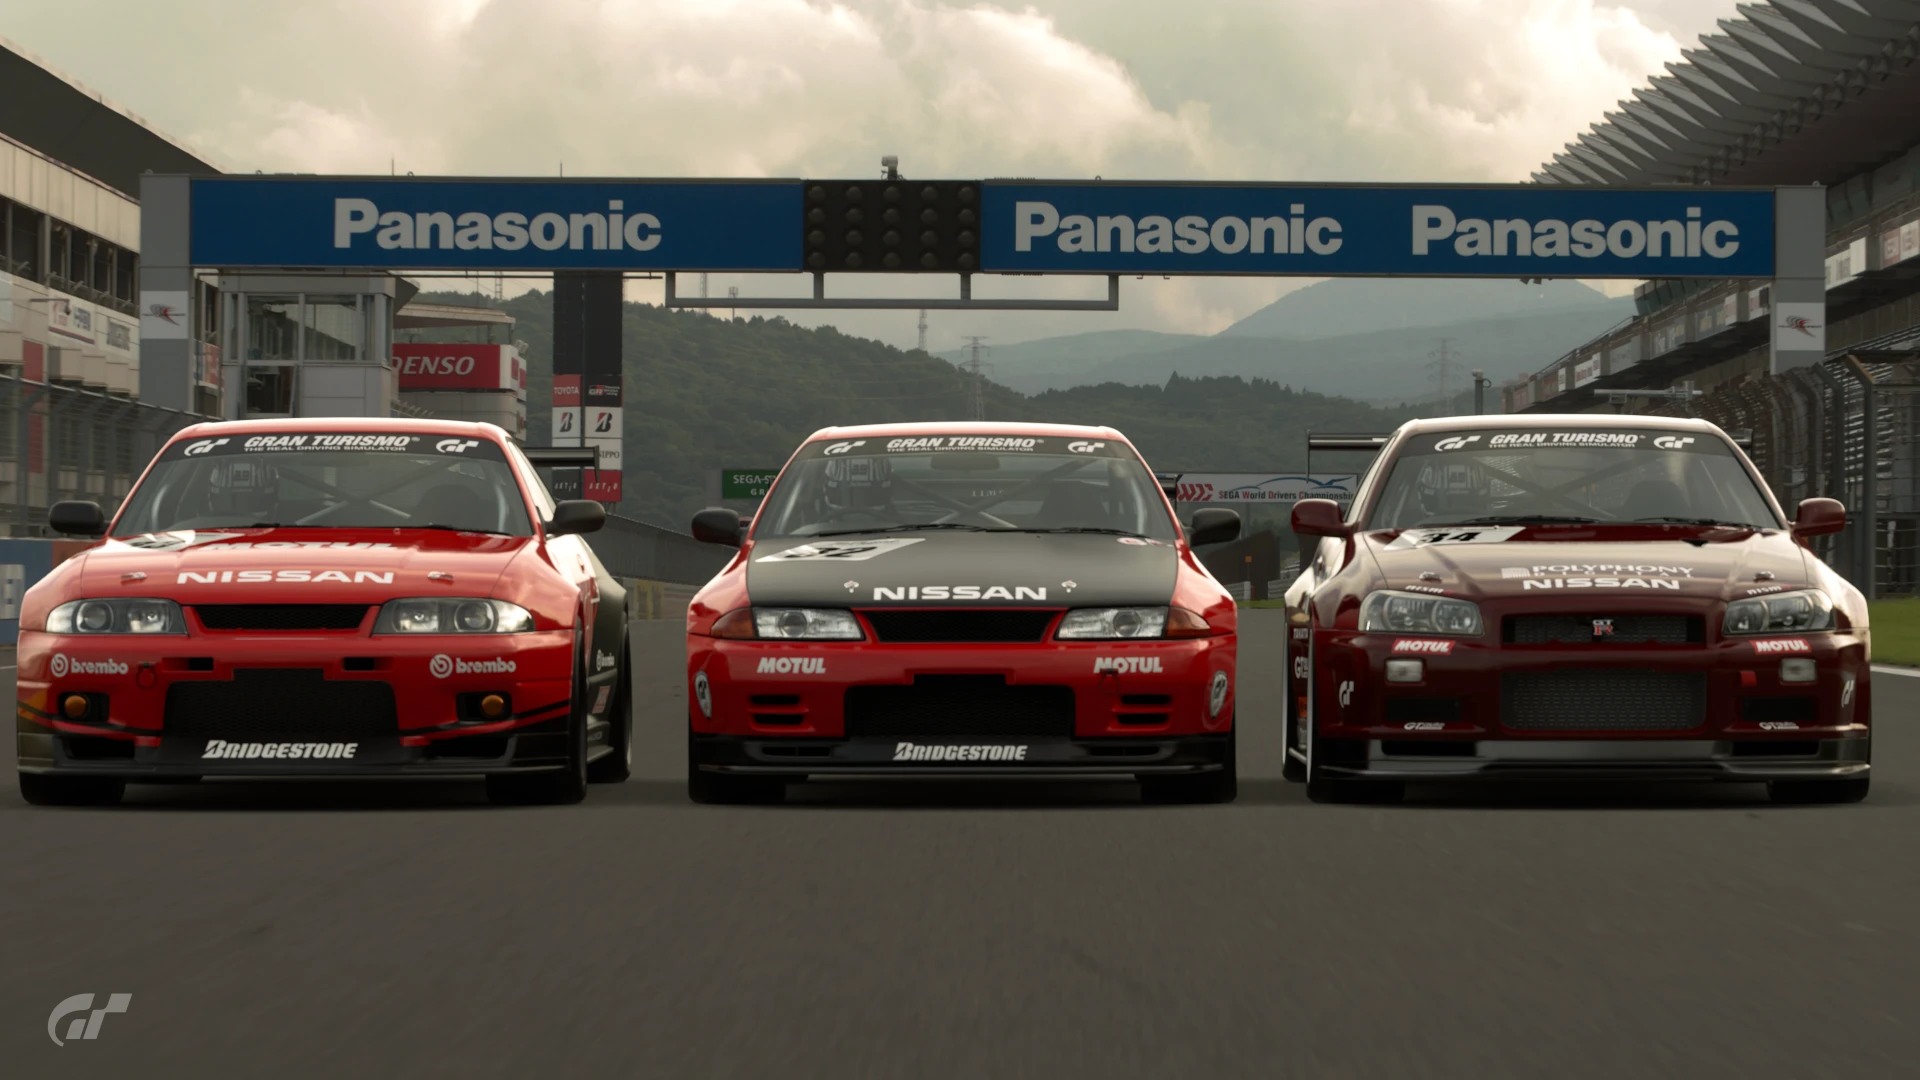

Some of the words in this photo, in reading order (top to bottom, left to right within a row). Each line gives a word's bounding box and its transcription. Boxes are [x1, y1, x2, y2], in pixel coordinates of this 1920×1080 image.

[334, 198, 661, 251] Panasonic
[1015, 201, 1342, 255] Panasonic
[1411, 204, 1739, 258] Panasonic
[553, 386, 580, 395] TOYOTA
[244, 435, 308, 447] GRAN
[312, 435, 410, 447] TURISMO
[886, 437, 944, 449] GRAN
[948, 437, 1036, 448] TURISMO
[1489, 433, 1547, 444] GRAN
[1552, 432, 1639, 444] TURISMO
[1219, 490, 1240, 499] SEGA
[1242, 490, 1266, 499] World
[1268, 490, 1297, 499] Drivers
[1531, 564, 1694, 574] POLYPHONY
[177, 570, 394, 584] NISSAN
[1523, 578, 1680, 590] NISSAN
[873, 586, 1046, 601] NISSAN
[1394, 640, 1450, 653] MOTUL
[1755, 640, 1809, 653] MOTUL
[71, 657, 128, 675] brembo
[455, 656, 516, 674] brembo
[757, 656, 827, 674] MOTUL
[1093, 656, 1164, 674] MOTUL
[201, 739, 358, 759] BRIDGESTONE
[892, 741, 1028, 761] BRIDGESTONE
